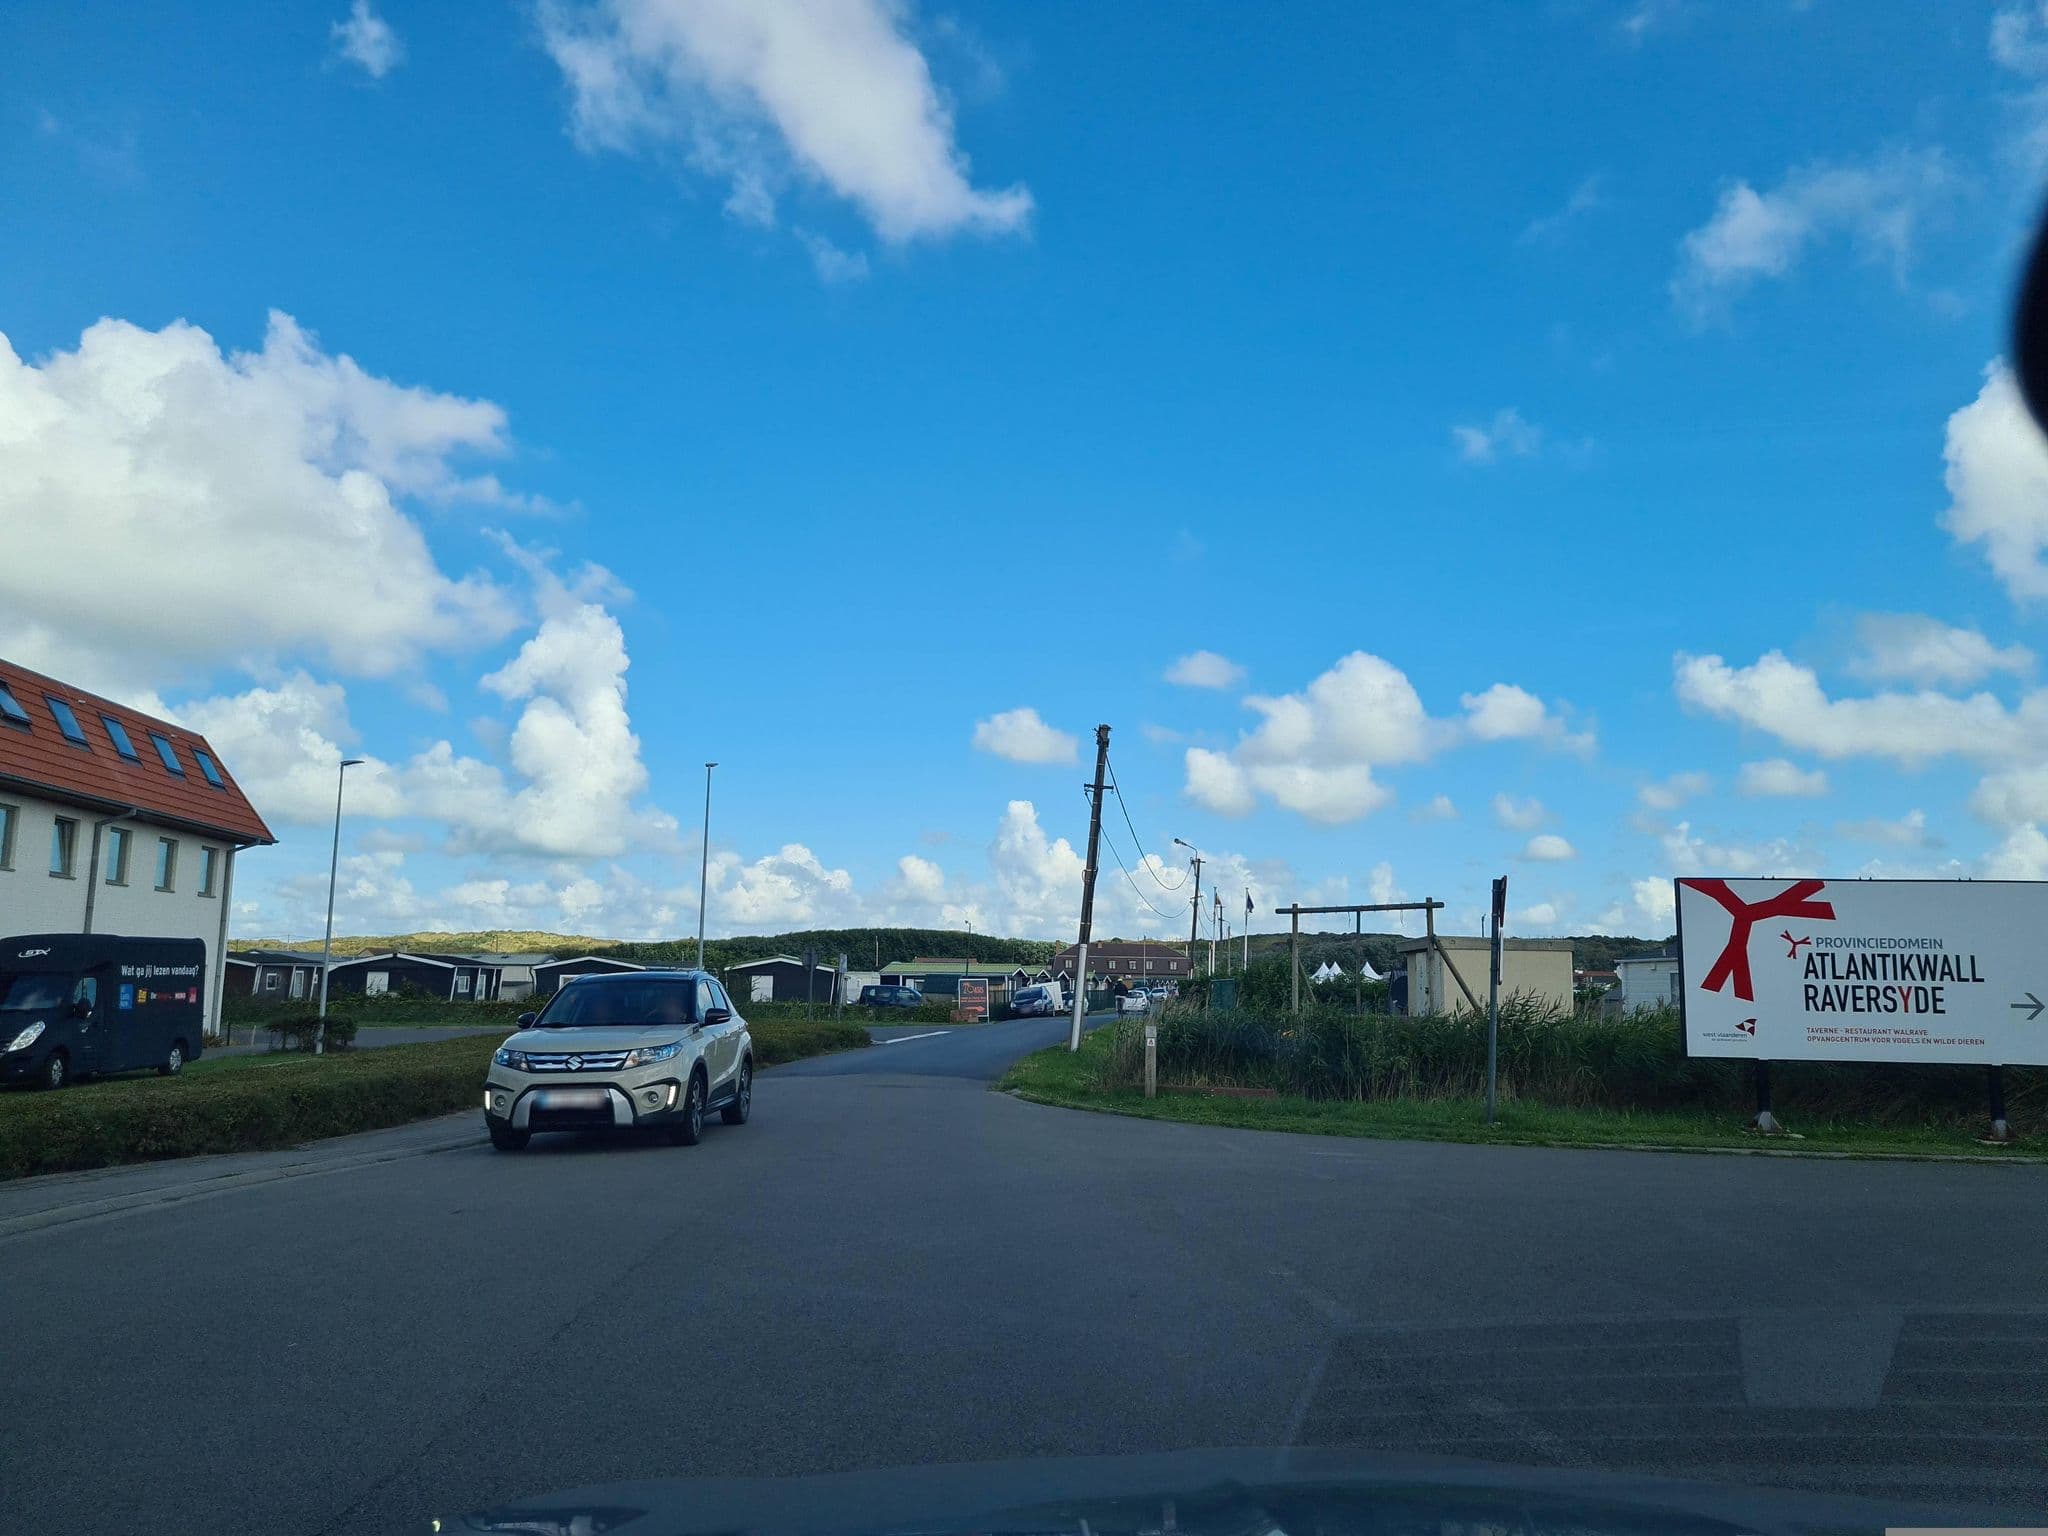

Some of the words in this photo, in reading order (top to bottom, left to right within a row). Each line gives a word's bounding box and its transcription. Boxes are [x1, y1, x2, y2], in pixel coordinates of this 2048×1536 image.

[1816, 938, 1943, 949] PROVINCIEDOMEIN
[121, 965, 134, 976] Wat
[136, 967, 144, 978] ga
[153, 965, 170, 975] lezen
[171, 965, 199, 977] vandaag?
[1803, 953, 1985, 982] ATLANTIKWALL
[1804, 984, 1946, 1014] RAVERSYDE
